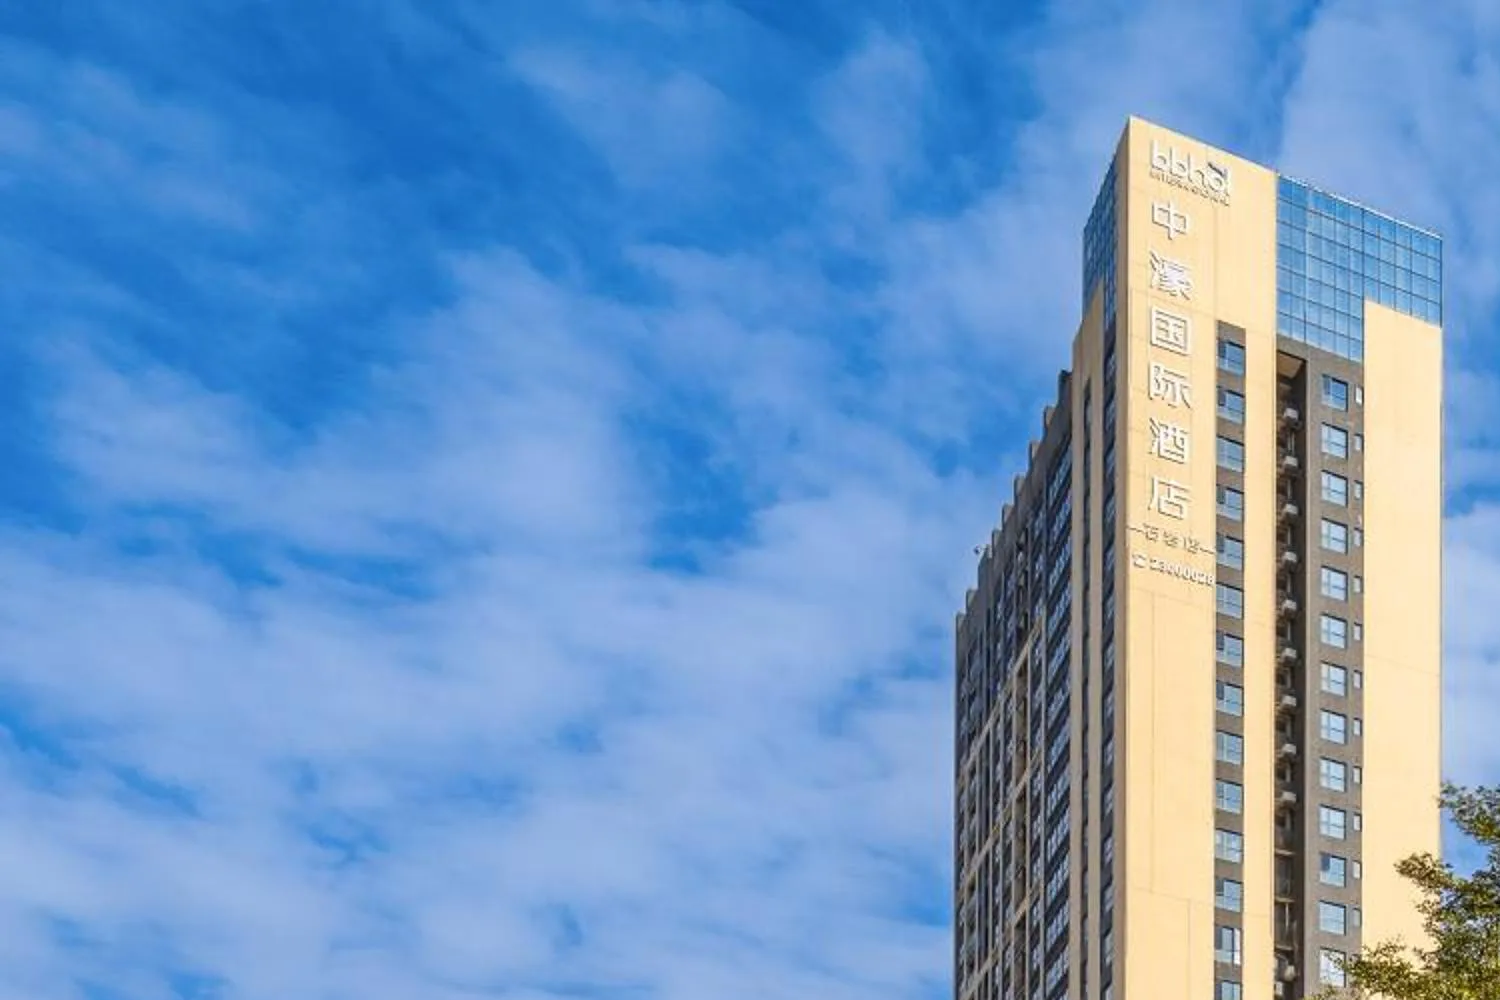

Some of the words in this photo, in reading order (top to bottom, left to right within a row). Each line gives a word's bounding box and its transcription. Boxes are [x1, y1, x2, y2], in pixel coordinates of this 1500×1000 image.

[1148, 200, 1194, 520] 中濠国际酒店
